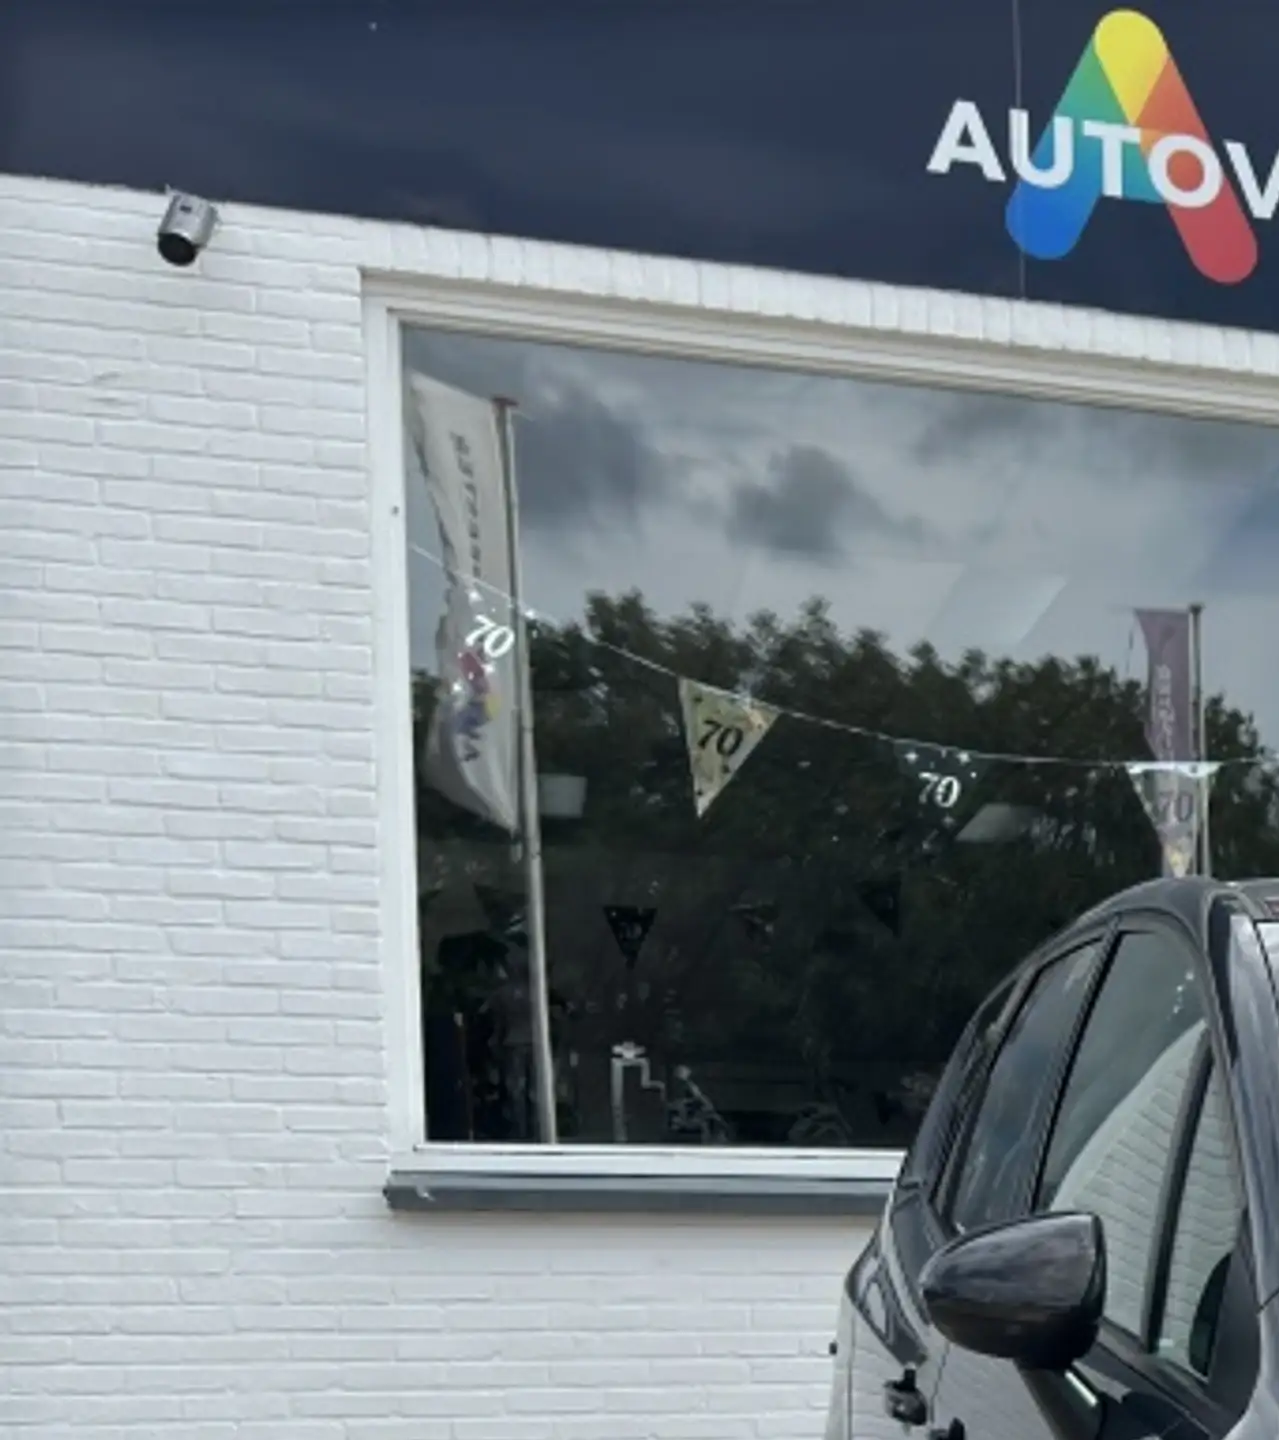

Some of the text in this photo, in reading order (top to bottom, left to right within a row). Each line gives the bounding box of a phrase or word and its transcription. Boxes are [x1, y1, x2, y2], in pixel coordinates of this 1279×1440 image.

[464, 614, 516, 660] 70
[695, 719, 745, 759] 70
[917, 771, 963, 809] 70
